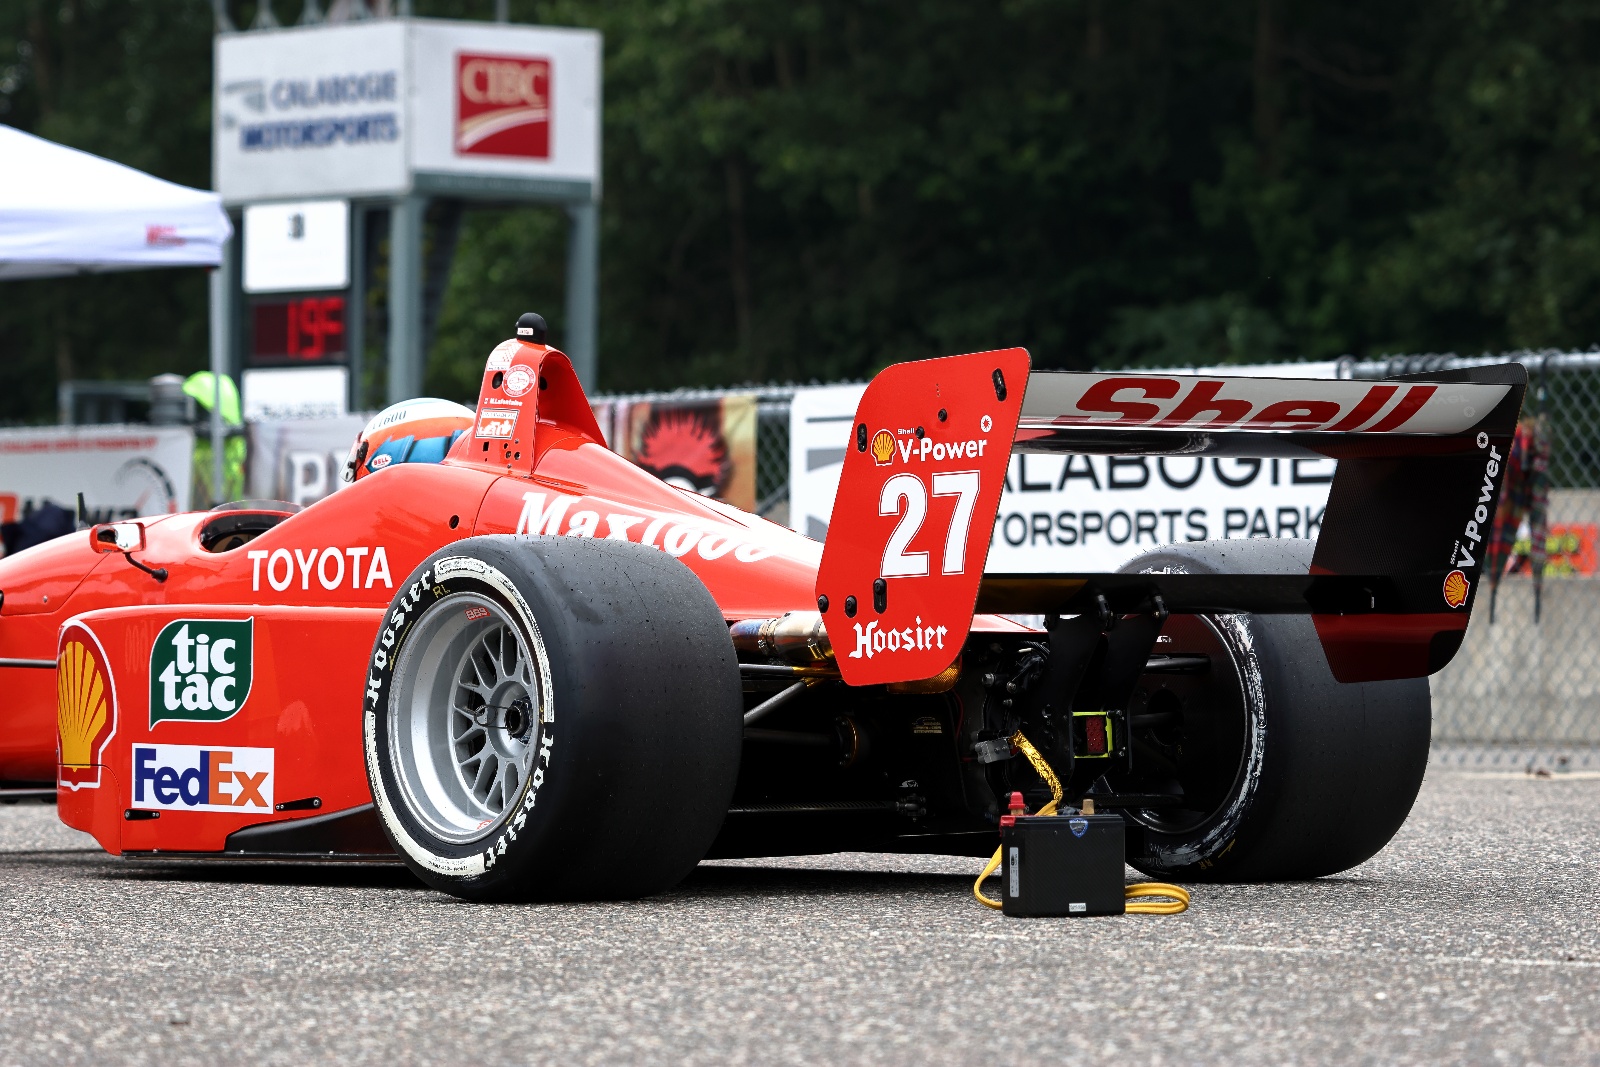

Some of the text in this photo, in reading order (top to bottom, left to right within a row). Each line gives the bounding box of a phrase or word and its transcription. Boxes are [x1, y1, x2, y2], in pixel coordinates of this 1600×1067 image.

[462, 58, 547, 107] CIBC
[1051, 377, 1438, 432] Shell
[897, 427, 915, 435] Shell
[897, 436, 988, 464] V-Power
[373, 456, 389, 467] BELL
[1003, 453, 1336, 493] LABOGIE
[878, 469, 980, 579] 27
[991, 507, 1208, 547] ORSPORTS
[1457, 444, 1502, 568] V-Power
[247, 546, 393, 592] TOYOTA
[171, 624, 236, 674] tic
[366, 569, 432, 708] Hoosier
[848, 616, 948, 659] Hoosier
[158, 660, 236, 712] tac
[134, 747, 269, 808] FedEx
[484, 727, 554, 871] Hoosier
